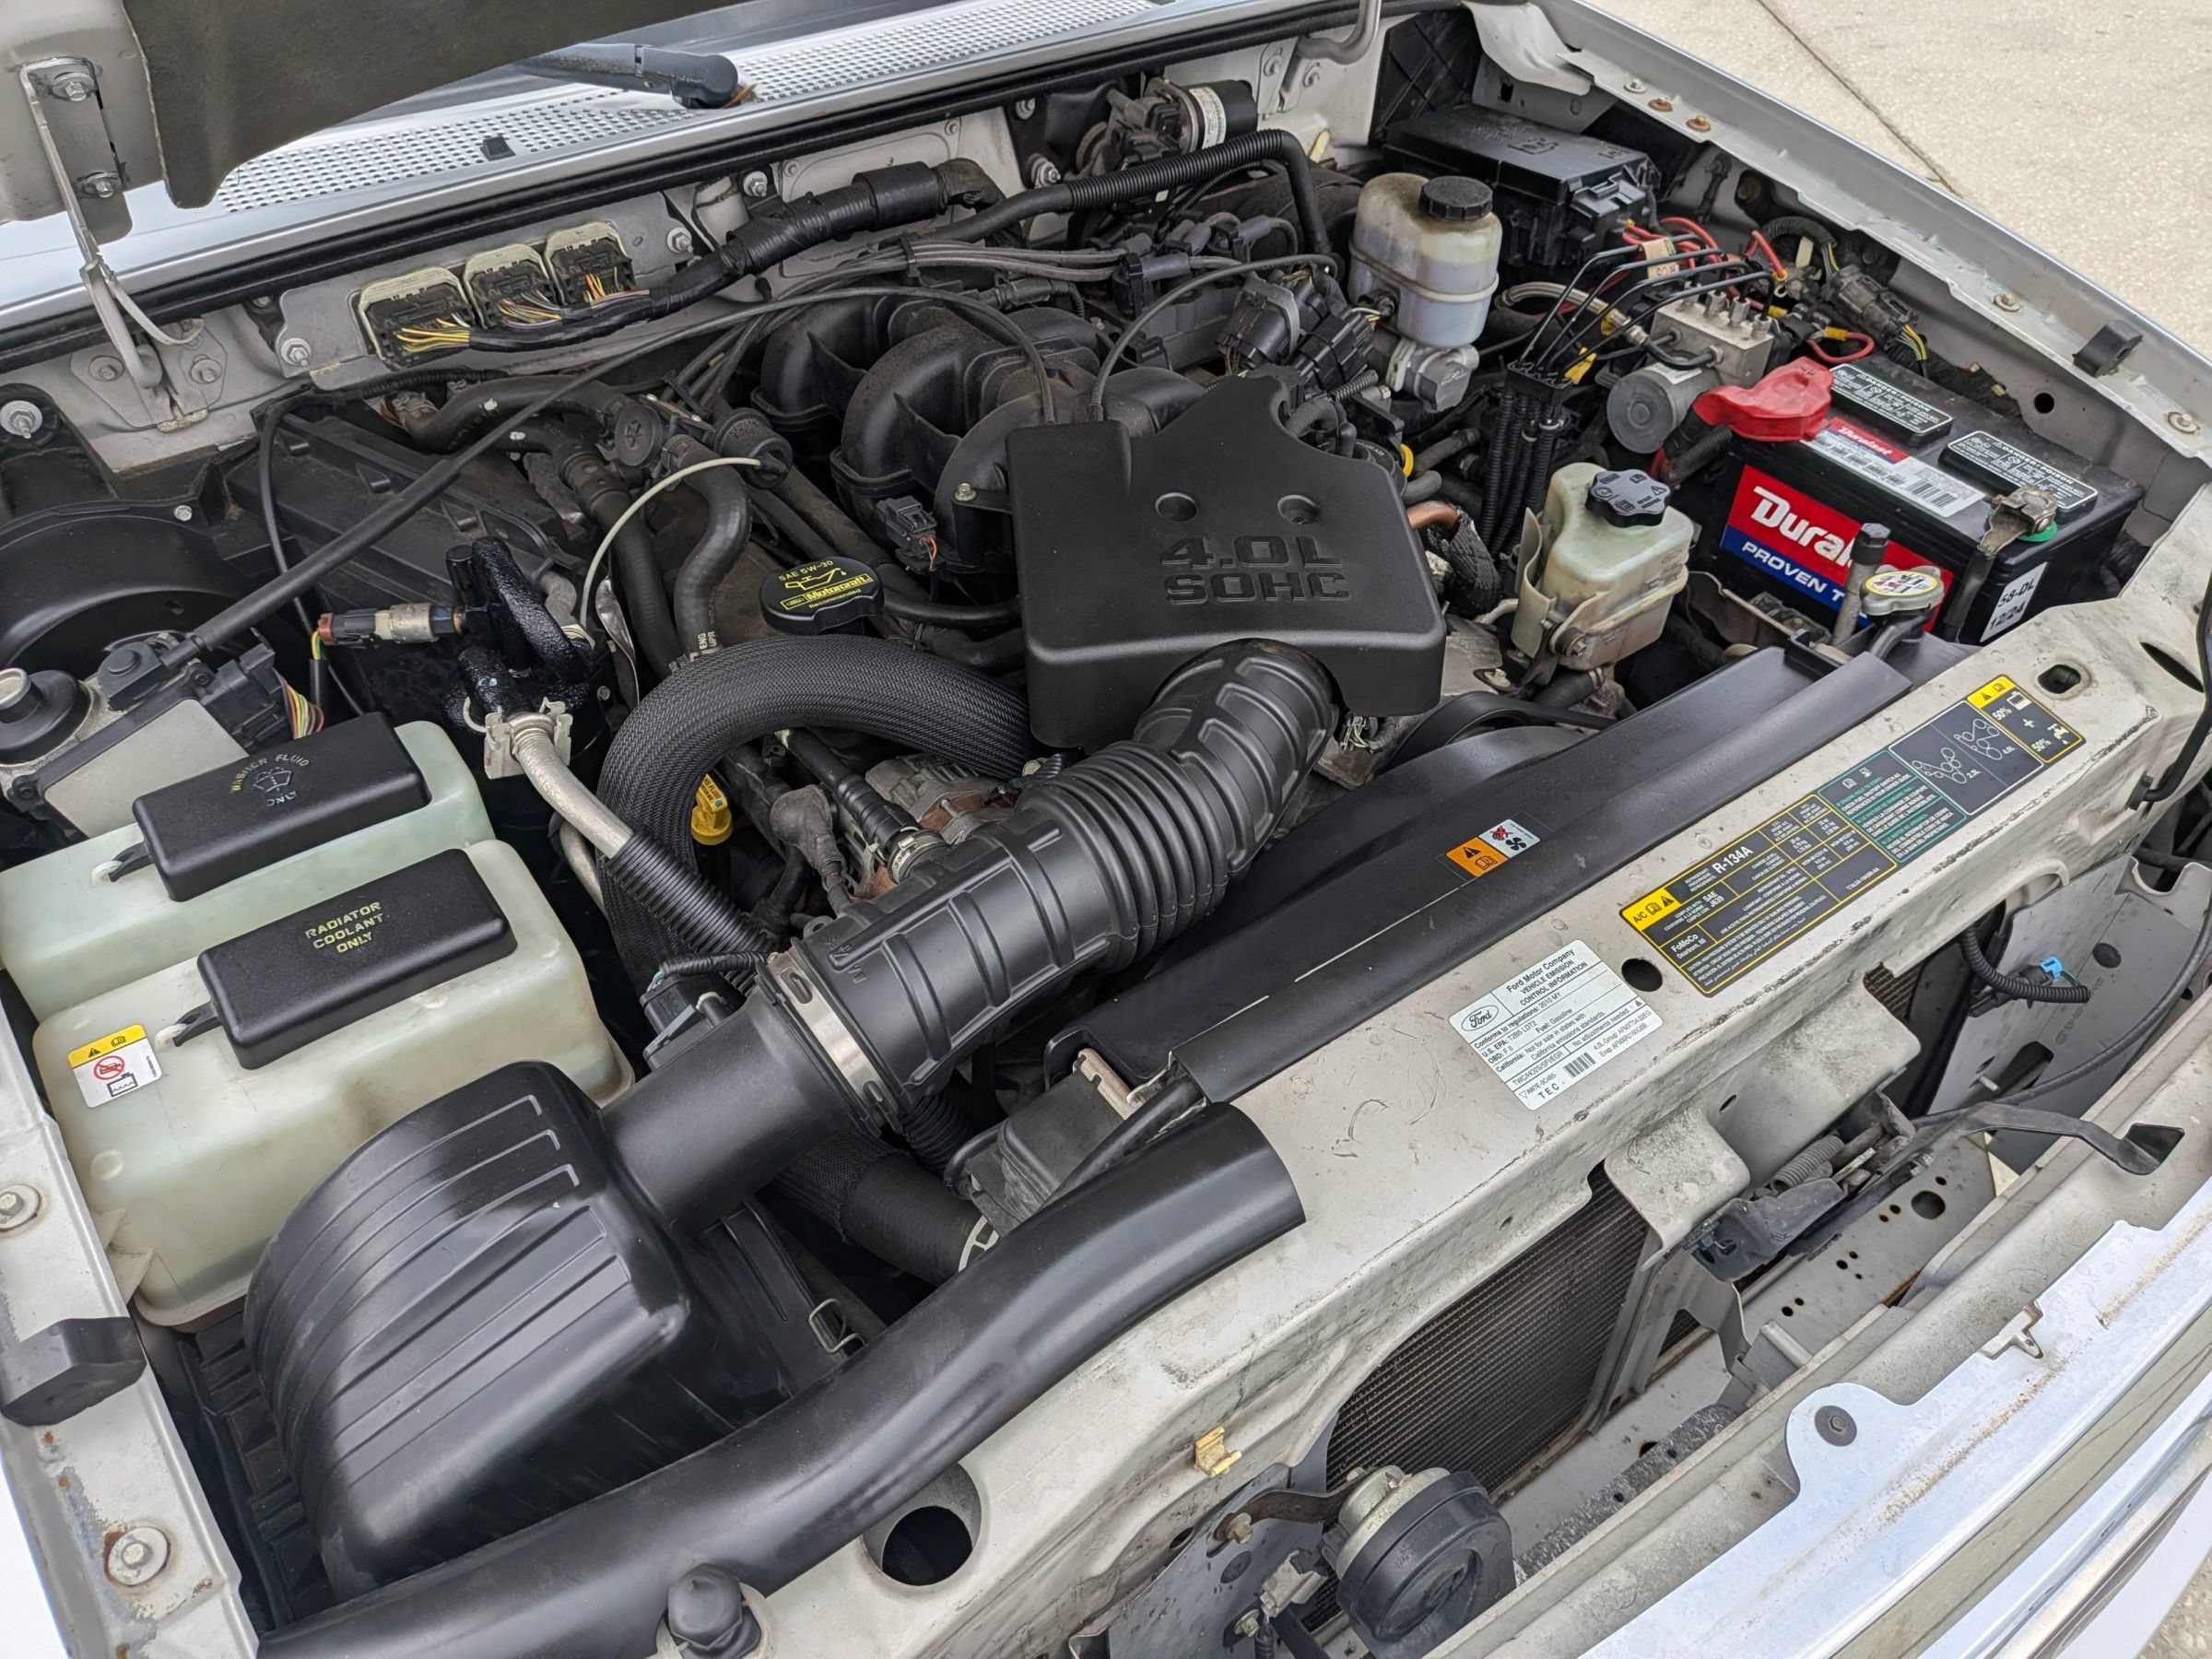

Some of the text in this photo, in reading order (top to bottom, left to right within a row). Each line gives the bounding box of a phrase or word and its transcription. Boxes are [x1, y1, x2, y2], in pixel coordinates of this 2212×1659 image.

[1836, 424, 1894, 457] Duralast
[1160, 535, 1343, 569] 4.0L
[778, 559, 834, 582] SAE 5W-30
[1741, 541, 1829, 594] PROVEN
[806, 575, 869, 602] Motorcraft
[808, 588, 863, 609] Recommended
[1163, 572, 1350, 605] SOHC
[1997, 578, 2035, 607] 58-DL
[1989, 601, 2026, 629] 12/24
[697, 632, 708, 650] ENG
[707, 630, 718, 647] UPR
[1992, 706, 2013, 721] 50%
[2031, 737, 2052, 752] 50%
[275, 754, 310, 767] FLUID
[1712, 844, 1754, 874] R-134A
[1702, 891, 1718, 902] SAE
[1709, 896, 1724, 907] J639
[305, 901, 382, 938] RADIATOR
[313, 912, 383, 949] COOLANT
[1631, 911, 1648, 923] A/C
[336, 931, 372, 953] ONLY
[1671, 933, 1699, 952] FoMoCo
[1677, 943, 1700, 959] Dearborn,
[1506, 948, 1576, 993] Ford Motor Company
[1519, 961, 1588, 1006] CONTROL INFORMATION
[1521, 959, 1574, 994] VEHICLE EMISSION
[1467, 1012, 1493, 1029] Ford
[1474, 1030, 1501, 1049] Conforms
[1507, 1006, 1541, 1029] regulations:
[1539, 998, 1553, 1007] 2010
[1535, 1008, 1573, 1033] Fuel: Gasoline
[1581, 1020, 1611, 1041] adjustments
[1609, 1007, 1630, 1022] needed.
[1482, 1048, 1495, 1057] U.S.
[1494, 1039, 1509, 1050] EPA:
[1522, 1020, 1537, 1031] LDT2
[1496, 1052, 1525, 1073] California:
[1524, 1045, 1535, 1053] Not
[1542, 1033, 1554, 1042] sale
[1559, 1019, 1575, 1031] states
[1573, 1013, 1585, 1021] with
[1531, 1010, 1606, 1060] California emissions standards.
[1488, 1052, 1504, 1064] OBD:
